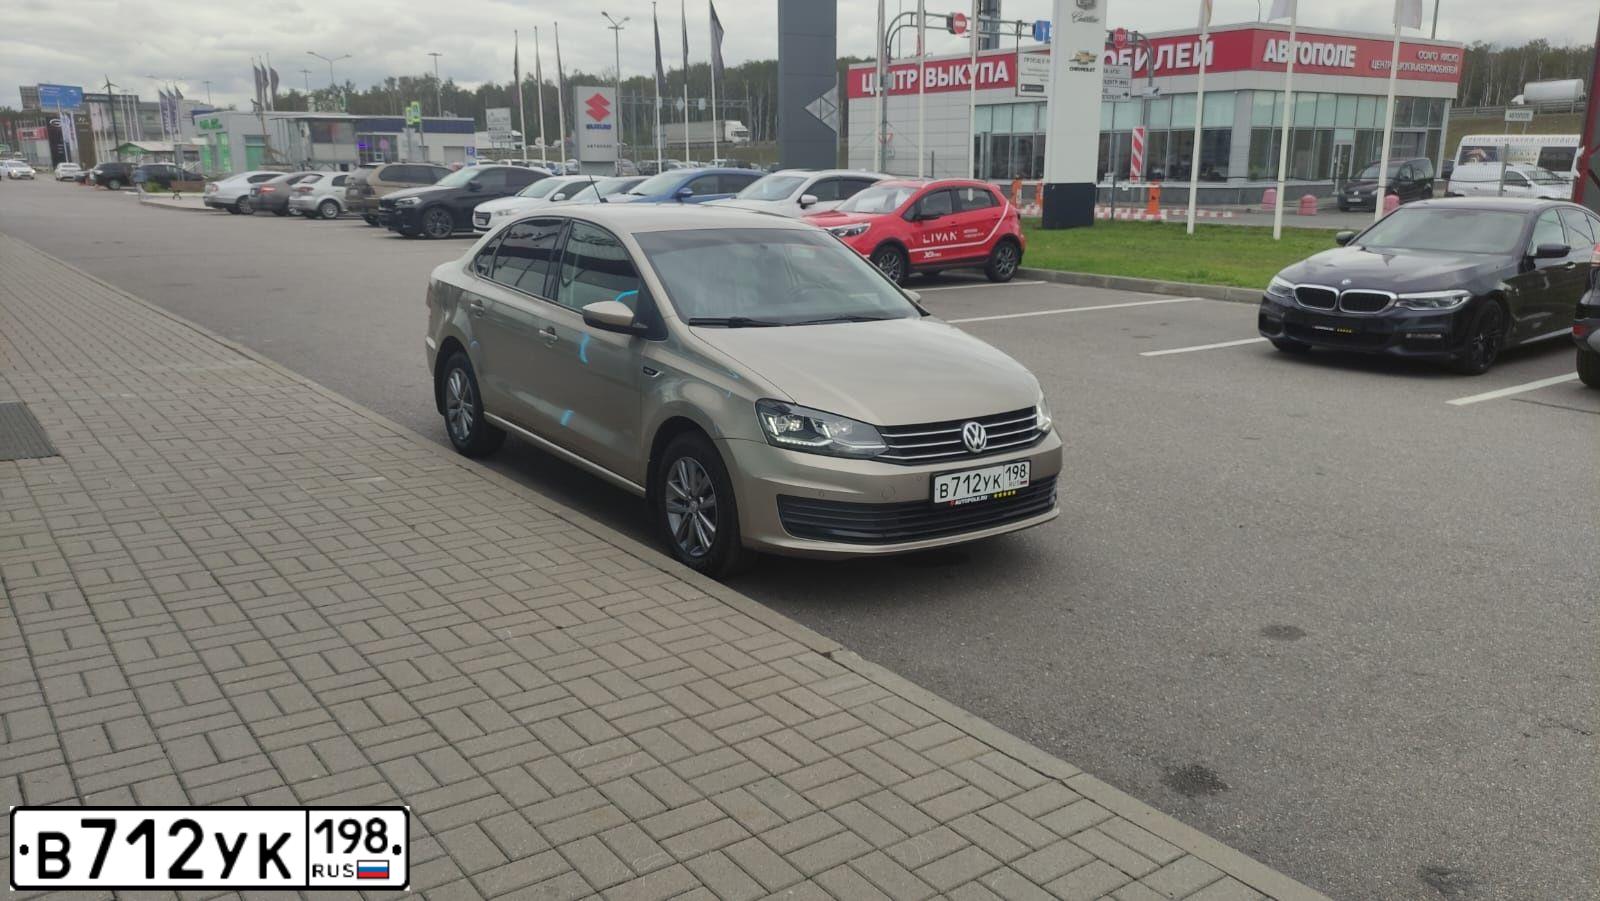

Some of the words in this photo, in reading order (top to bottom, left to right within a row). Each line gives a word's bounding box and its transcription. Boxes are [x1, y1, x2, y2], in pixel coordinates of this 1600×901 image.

[1263, 38, 1356, 68] АВТОПОЛЕ
[925, 61, 1009, 88] ВЫКУПА
[922, 231, 957, 244] LIVAN
[940, 473, 1002, 498] В712УК
[1005, 463, 1026, 481] 198
